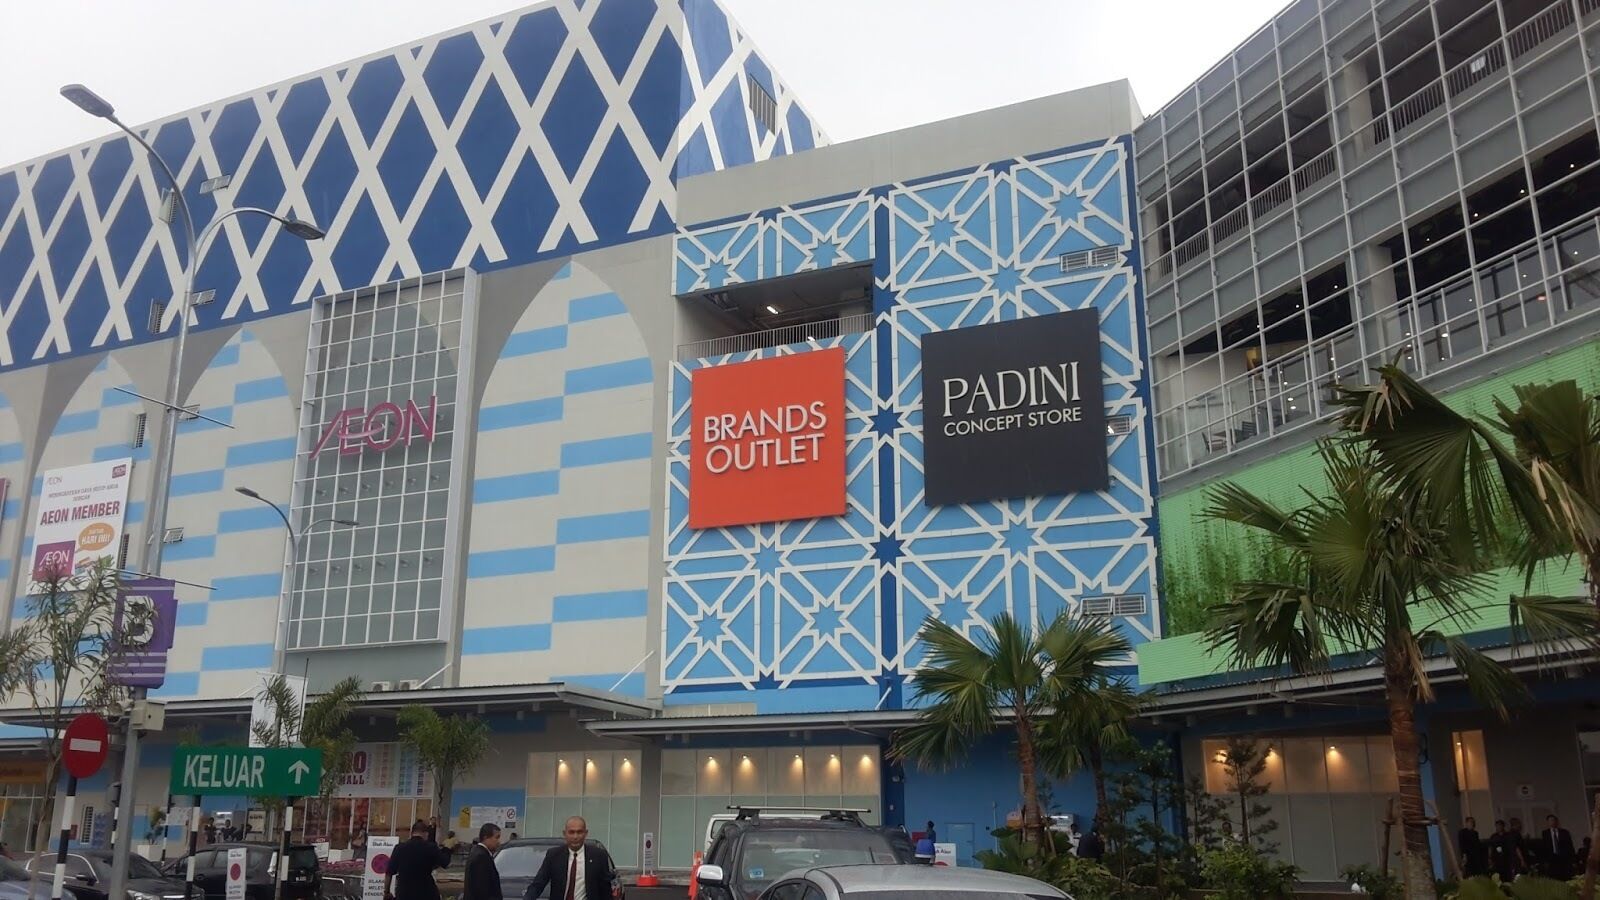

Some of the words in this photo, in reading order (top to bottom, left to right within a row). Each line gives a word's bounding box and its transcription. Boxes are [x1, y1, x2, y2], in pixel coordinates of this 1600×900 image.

[943, 361, 1080, 417] PADINI
[704, 401, 827, 443] BRANDS
[944, 413, 1023, 436] CONCEPT
[1028, 407, 1081, 427] STORE
[706, 433, 825, 474] OUTLET
[40, 508, 69, 525] AEON
[72, 501, 120, 520] MEMBER
[183, 755, 265, 788] KELUAR
